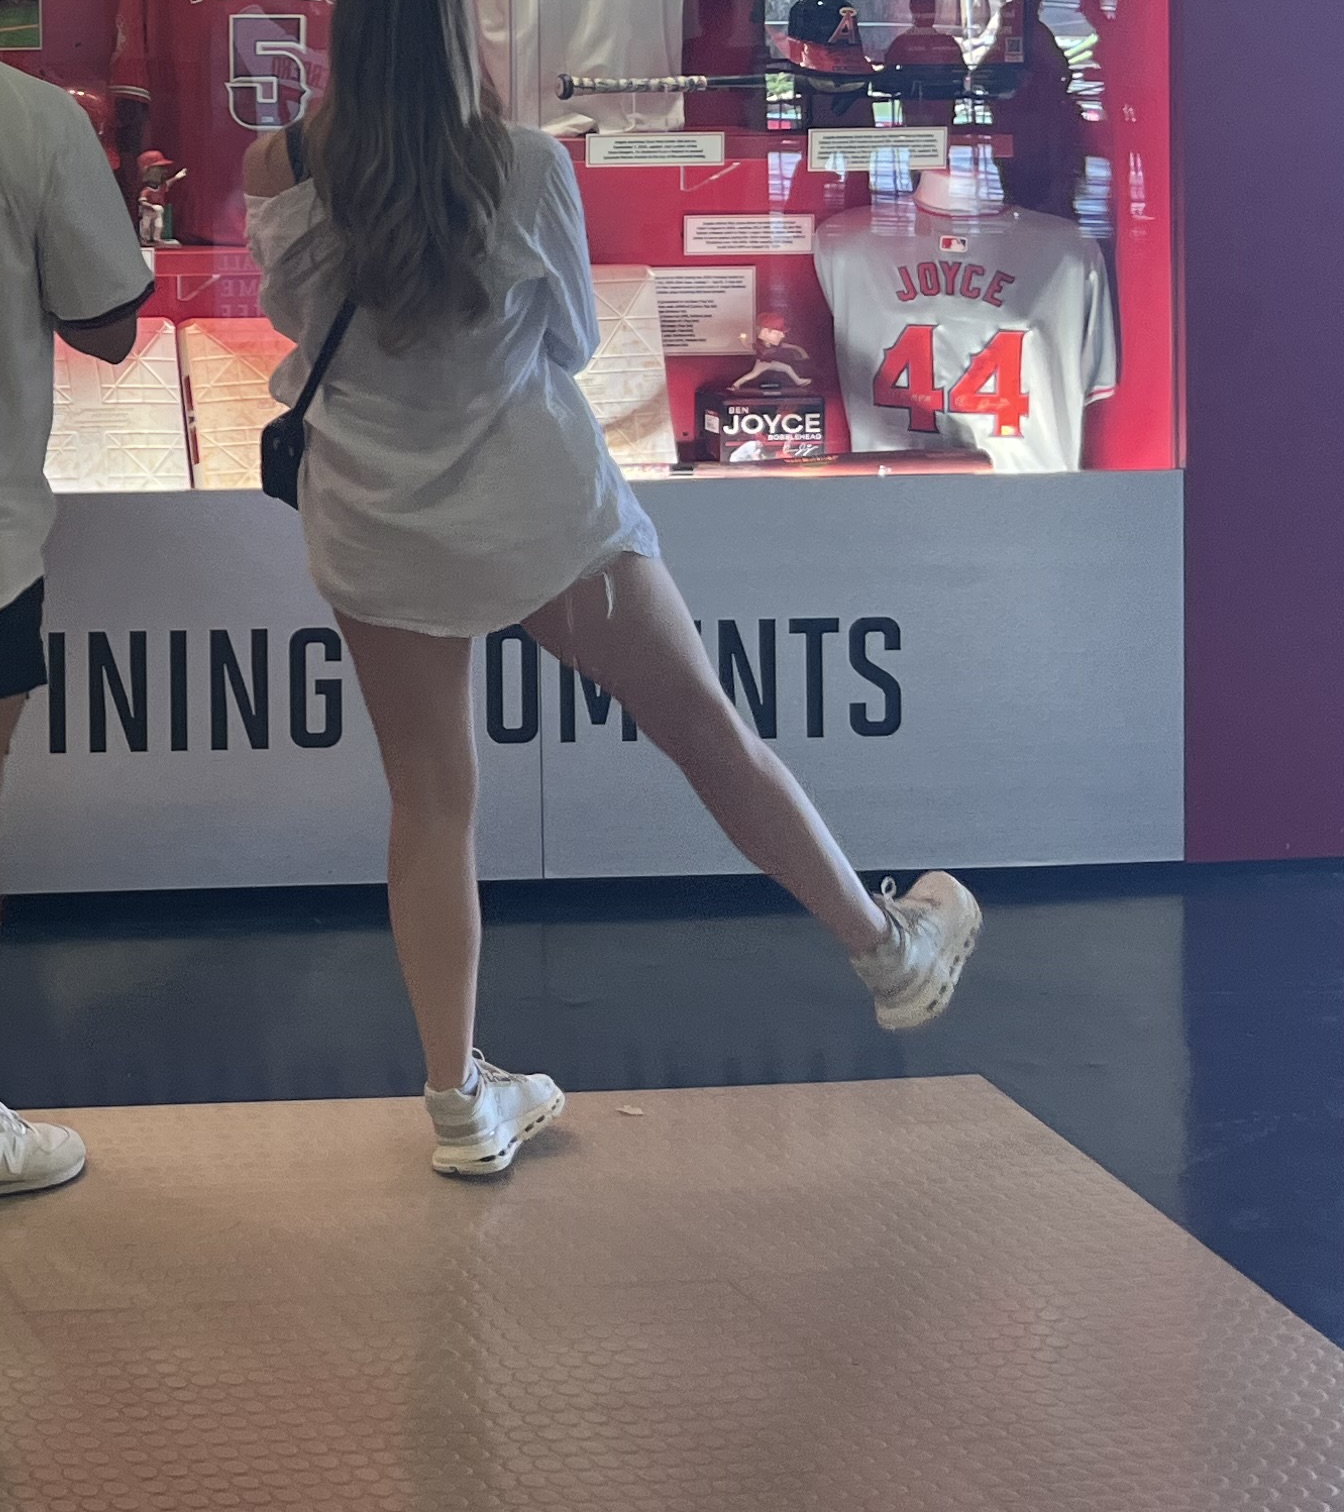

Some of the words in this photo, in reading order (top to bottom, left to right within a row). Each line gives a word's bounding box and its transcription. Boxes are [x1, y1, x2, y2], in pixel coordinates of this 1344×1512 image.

[225, 13, 312, 130] 5
[896, 260, 1016, 308] JOYCE
[873, 324, 1030, 439] 44
[722, 413, 821, 435] JOYCE
[728, 406, 750, 414] BEN
[768, 433, 822, 441] BOBBLEHEAD
[485, 616, 902, 745] OMNTS
